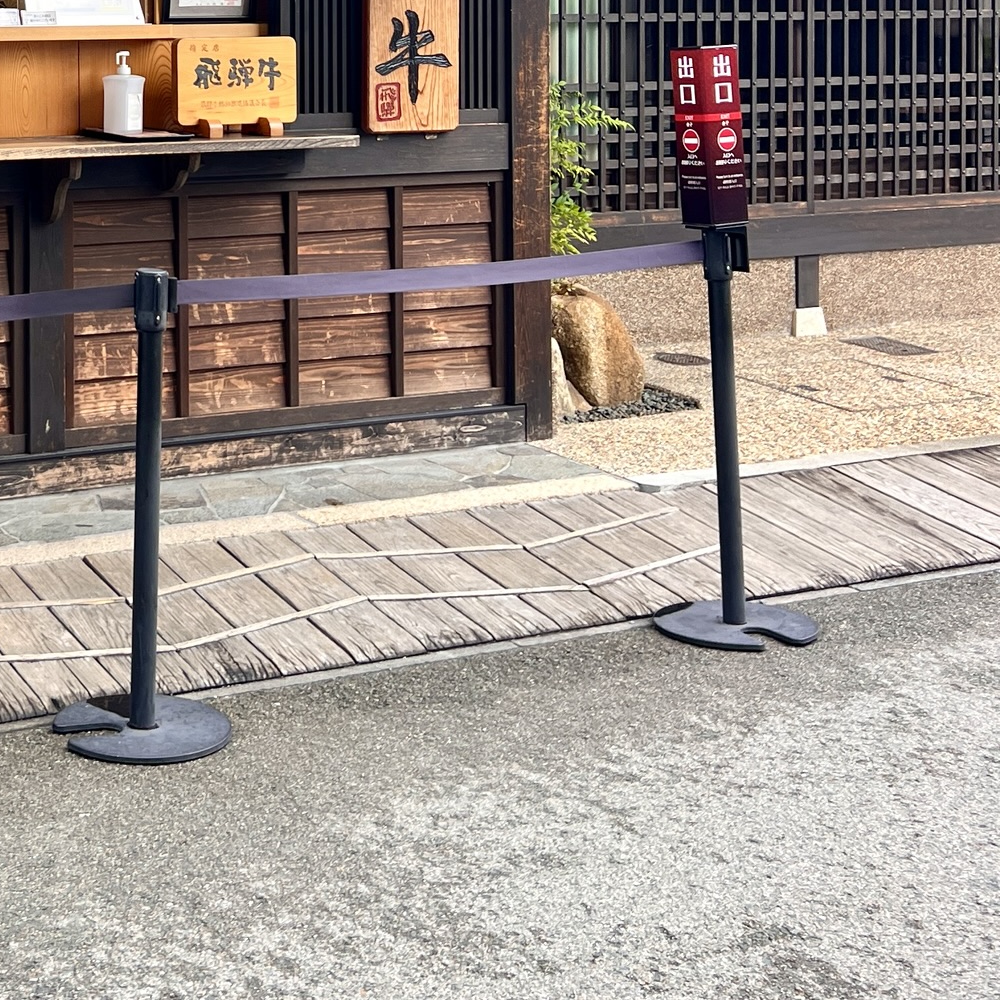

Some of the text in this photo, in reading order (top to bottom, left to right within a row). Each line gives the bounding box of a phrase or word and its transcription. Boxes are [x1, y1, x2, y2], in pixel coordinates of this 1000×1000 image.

[193, 57, 282, 91] 飛騨牛
[677, 55, 697, 105] 出口
[712, 53, 734, 104] 出口
